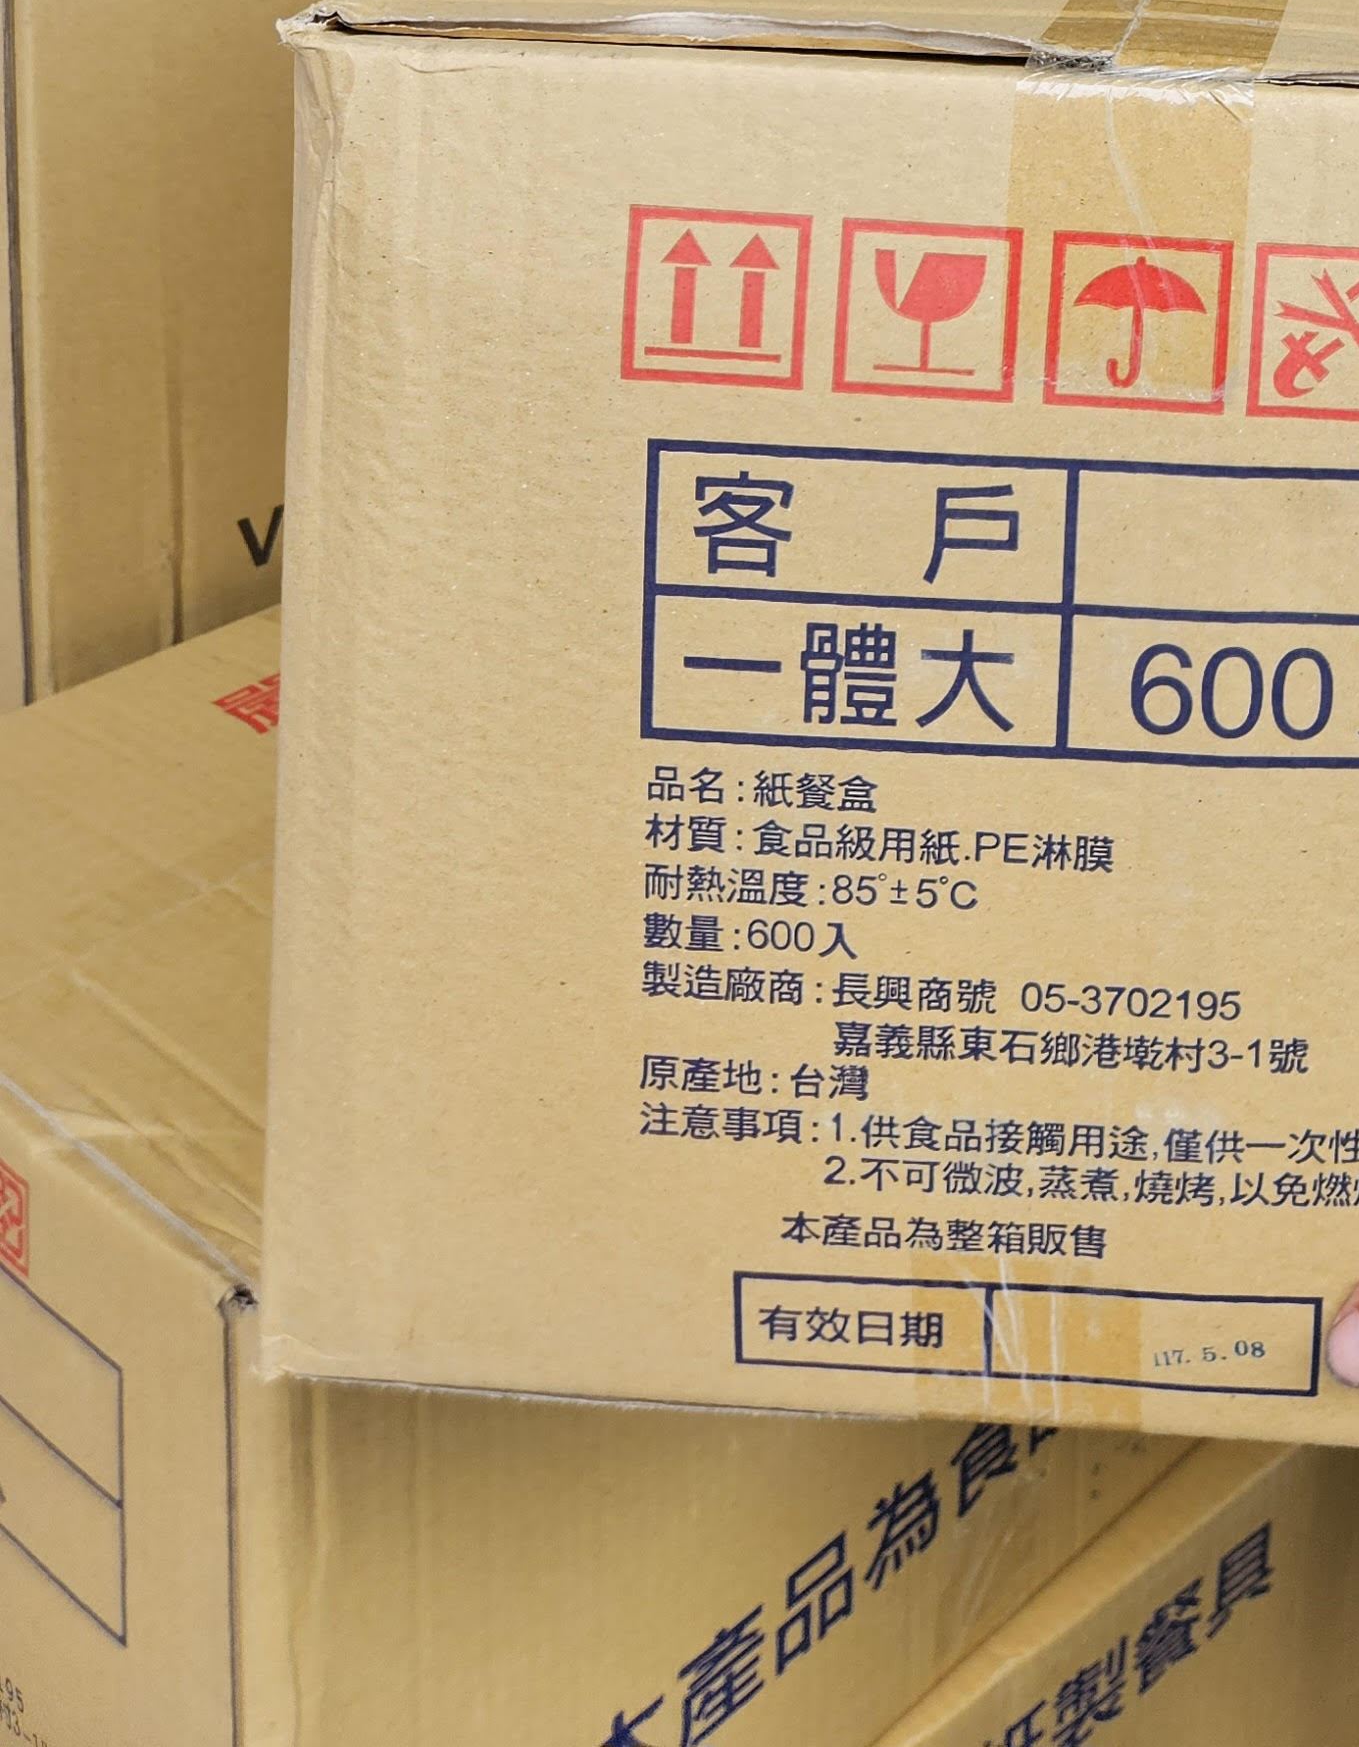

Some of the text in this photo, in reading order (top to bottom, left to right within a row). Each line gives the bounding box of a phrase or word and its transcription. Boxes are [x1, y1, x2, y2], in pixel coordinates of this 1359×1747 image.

[684, 622, 1015, 732] 一體大
[1021, 982, 1242, 1021] 05-3702195
[781, 1210, 1107, 1260] 本產品為整箱販售
[758, 1304, 945, 1350] 有效日期
